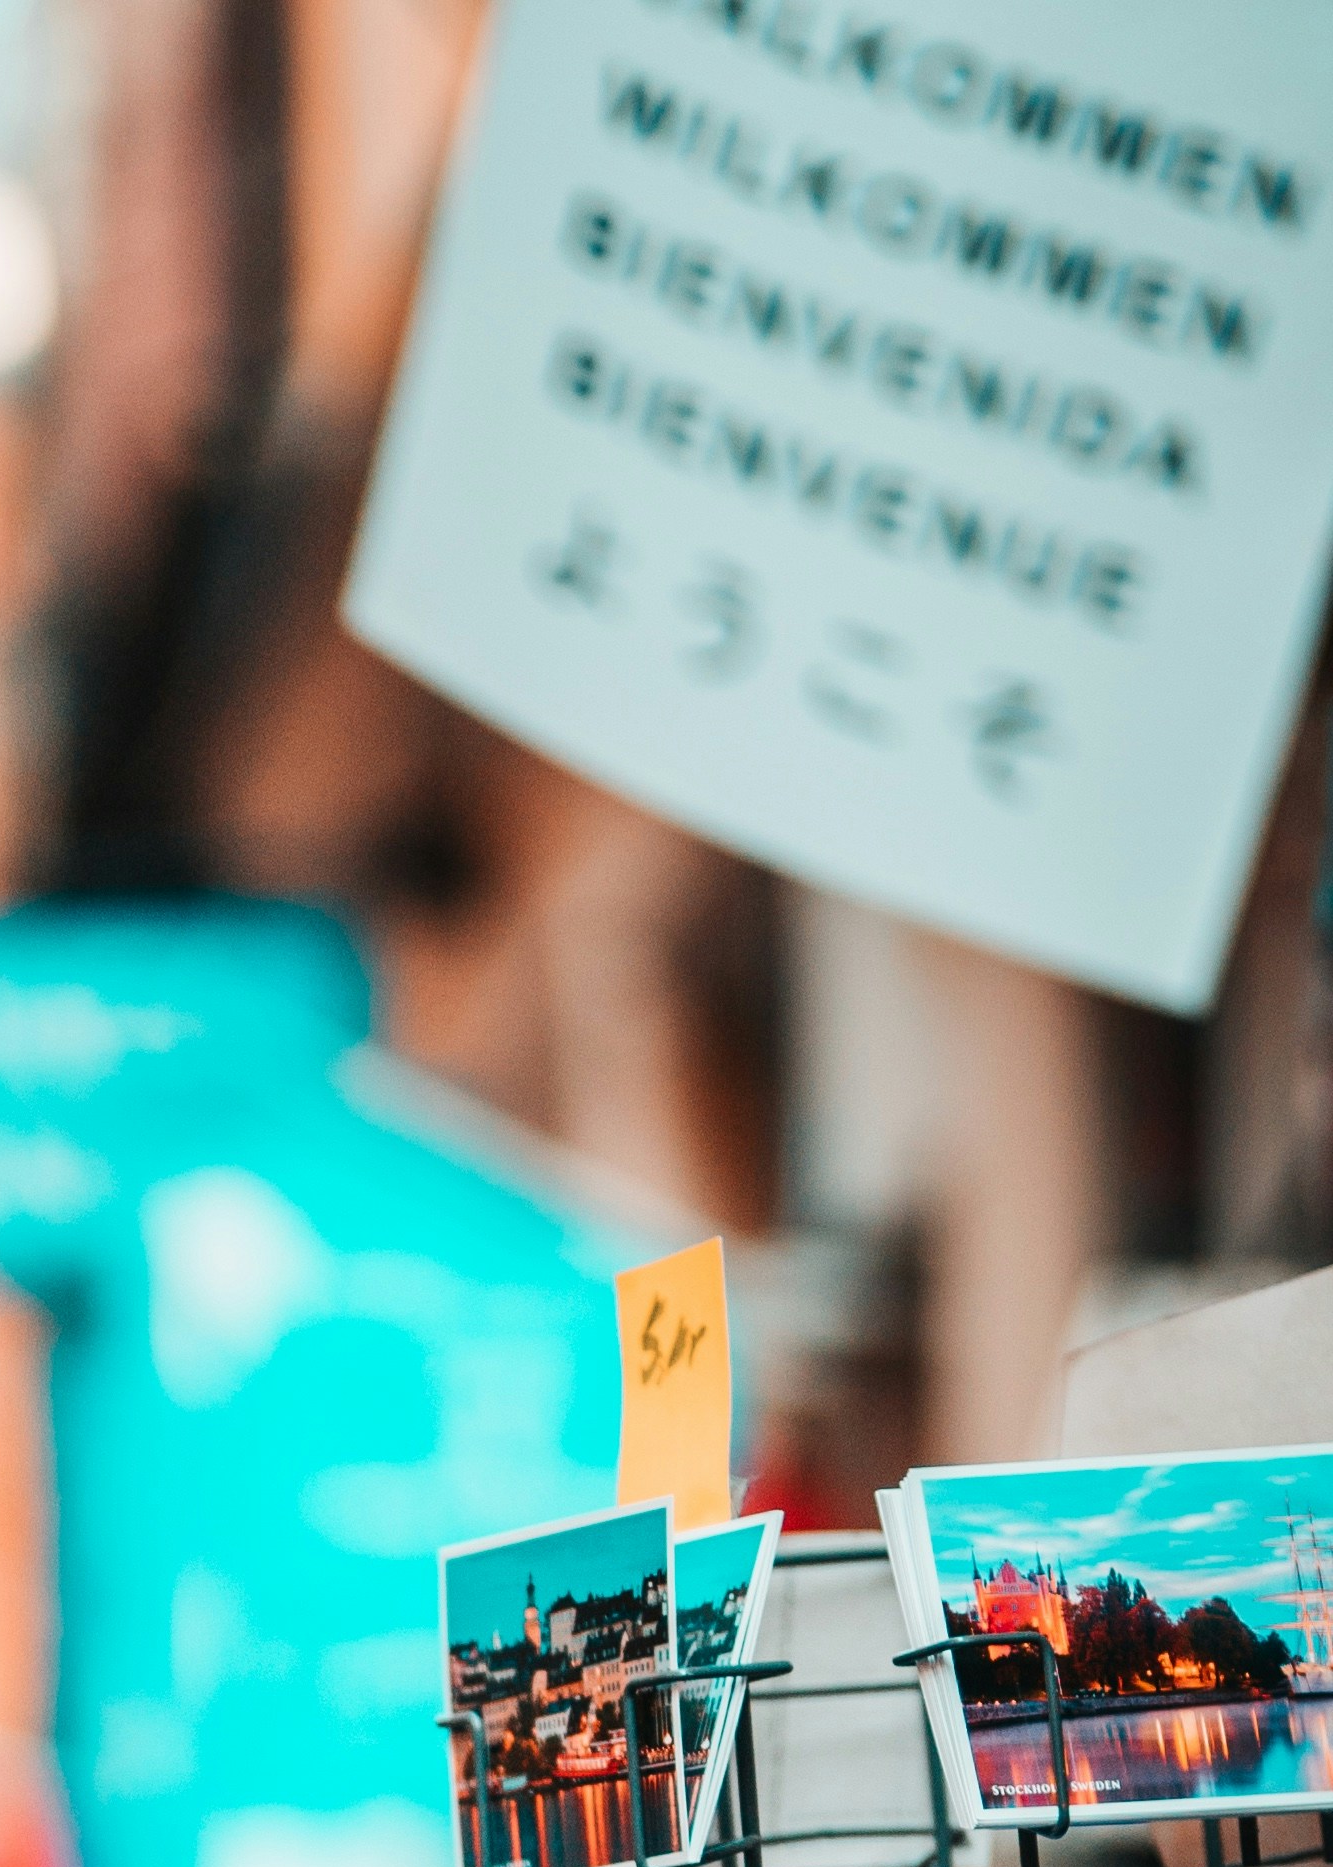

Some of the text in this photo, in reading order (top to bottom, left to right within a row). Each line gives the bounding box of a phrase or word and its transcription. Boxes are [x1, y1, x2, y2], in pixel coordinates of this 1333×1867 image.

[569, 192, 1203, 498] BIENVENIDA
[603, 66, 1263, 362] WILKOMMEN
[552, 332, 1139, 630] BIENVENUE
[533, 502, 1063, 806] ようこそ
[1070, 1779, 1121, 1792] SWEDEN
